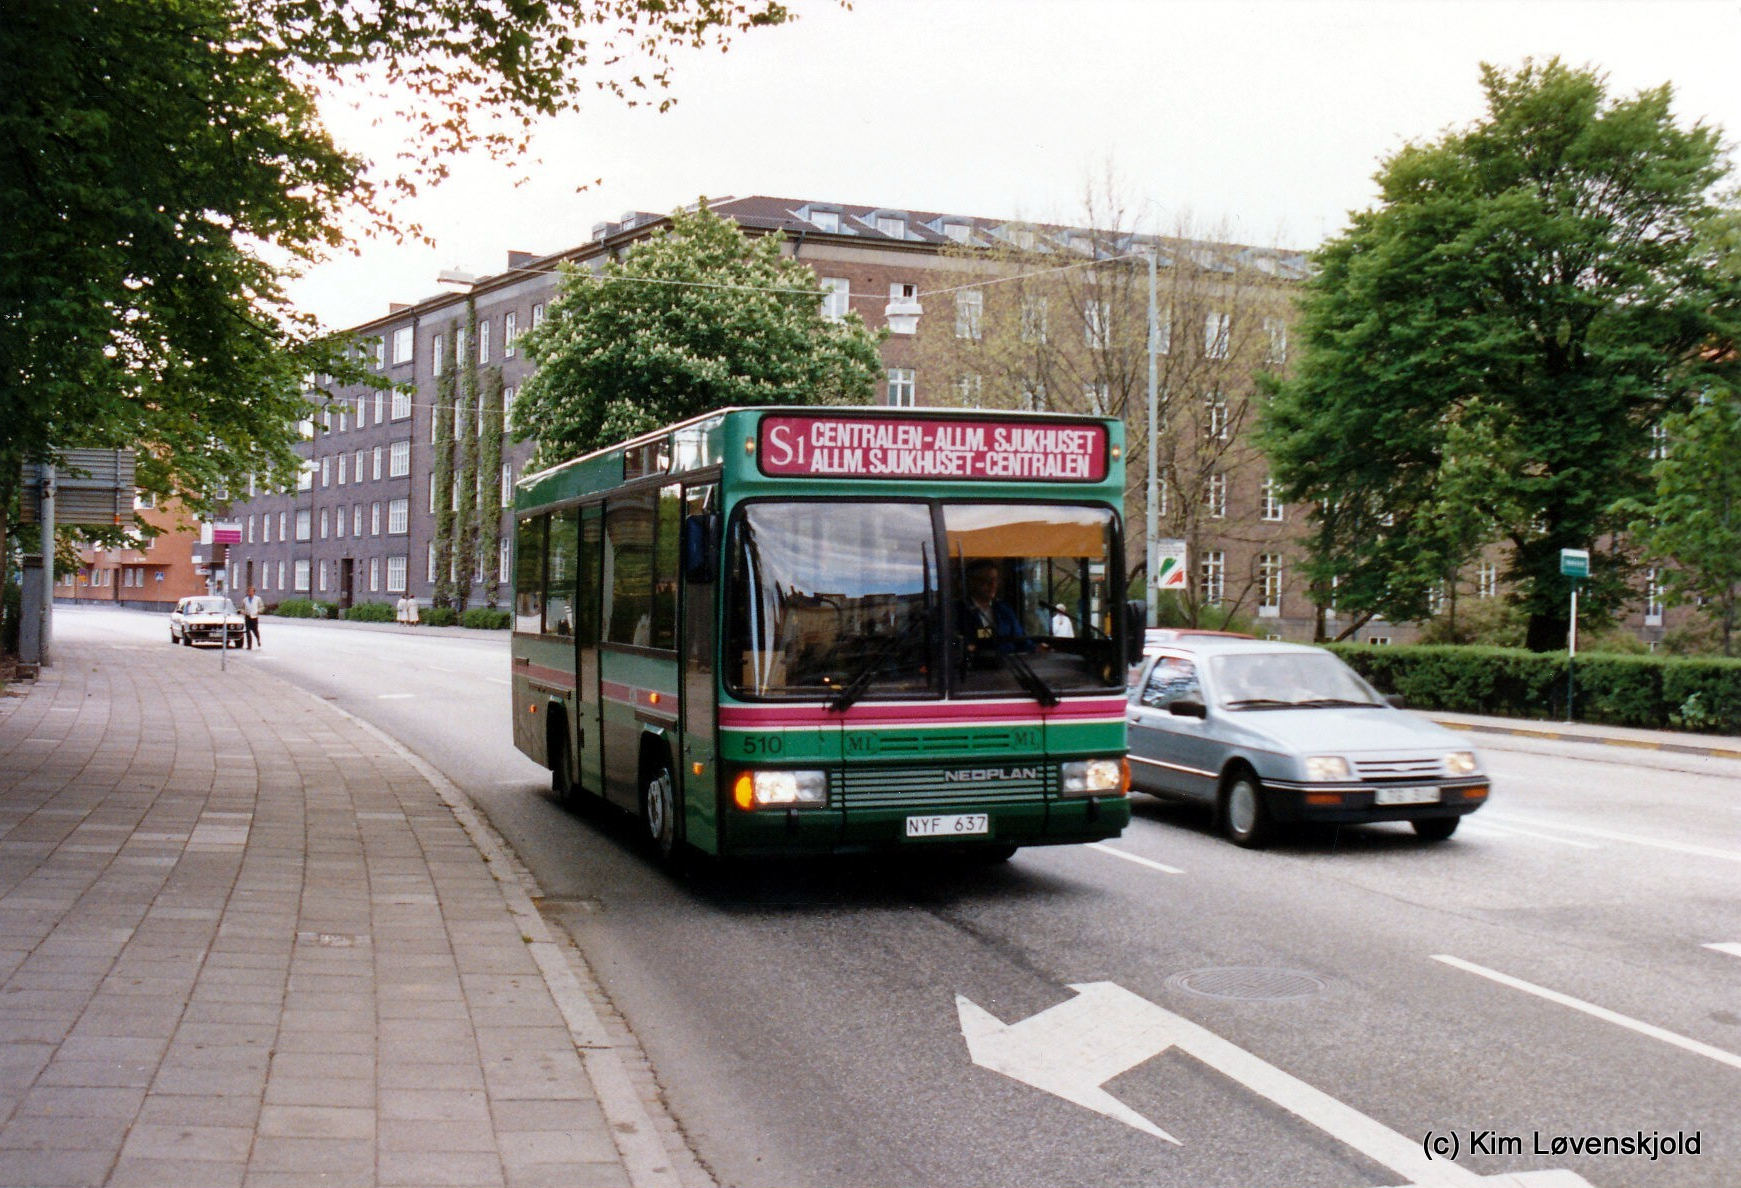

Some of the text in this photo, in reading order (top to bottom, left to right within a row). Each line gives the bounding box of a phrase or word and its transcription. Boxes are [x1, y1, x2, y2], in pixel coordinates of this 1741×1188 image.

[770, 425, 804, 465] S1
[994, 428, 1096, 454] SJUKHUSET
[810, 449, 866, 473] ALLM.
[743, 736, 782, 754] 510
[945, 768, 1036, 781] NEOPLAN
[909, 816, 986, 833] NYF 637
